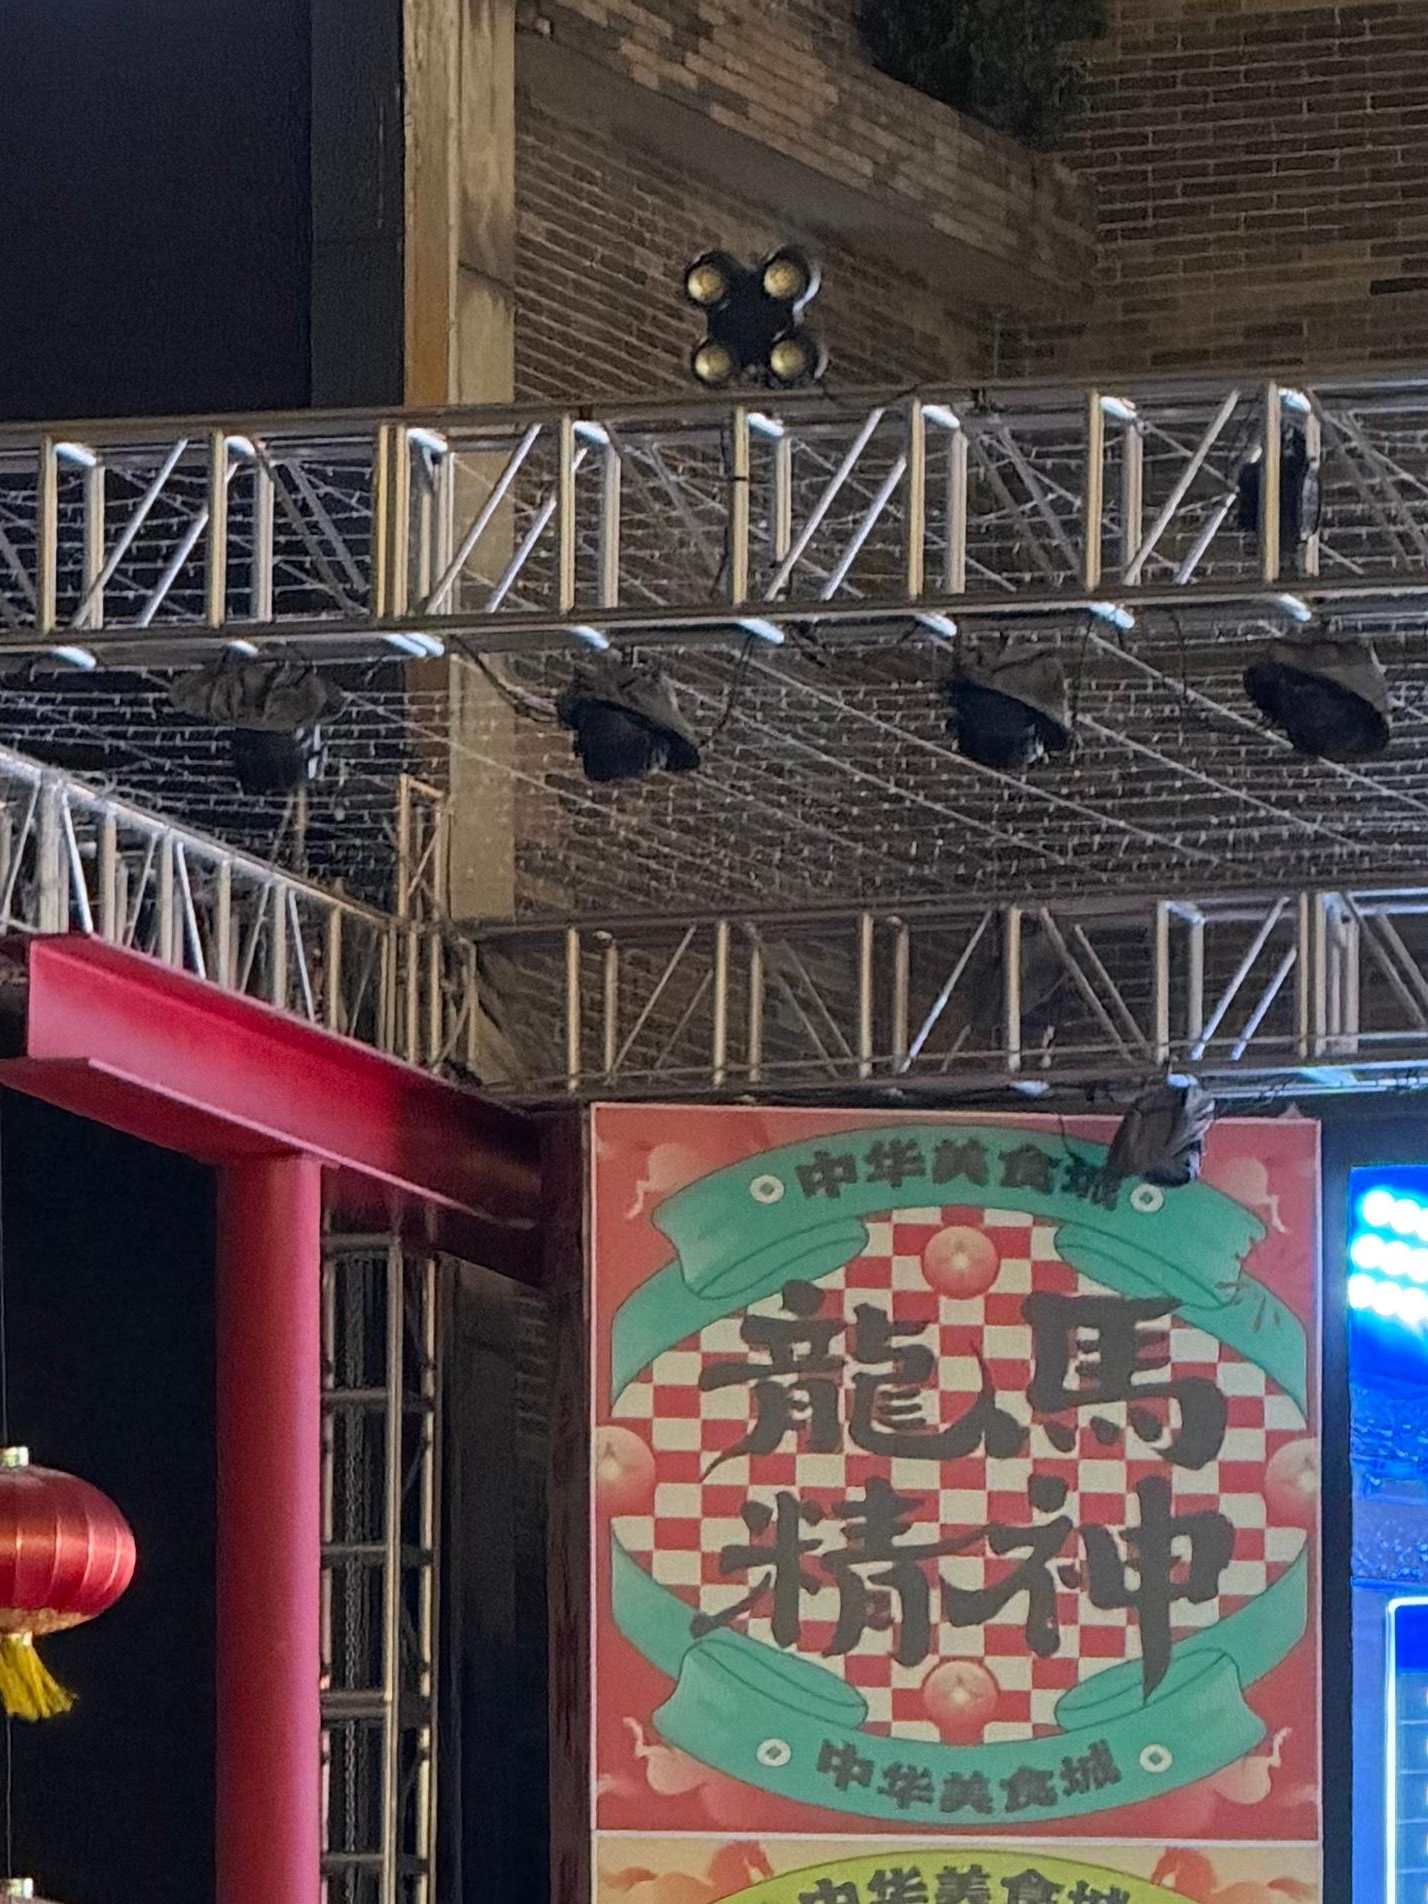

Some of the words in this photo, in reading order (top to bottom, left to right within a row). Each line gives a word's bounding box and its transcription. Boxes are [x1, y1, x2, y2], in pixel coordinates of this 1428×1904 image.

[794, 1138, 1122, 1211] 中华美食城
[689, 1473, 1235, 1706] 精神
[815, 1739, 1122, 1815] 中华美食城
